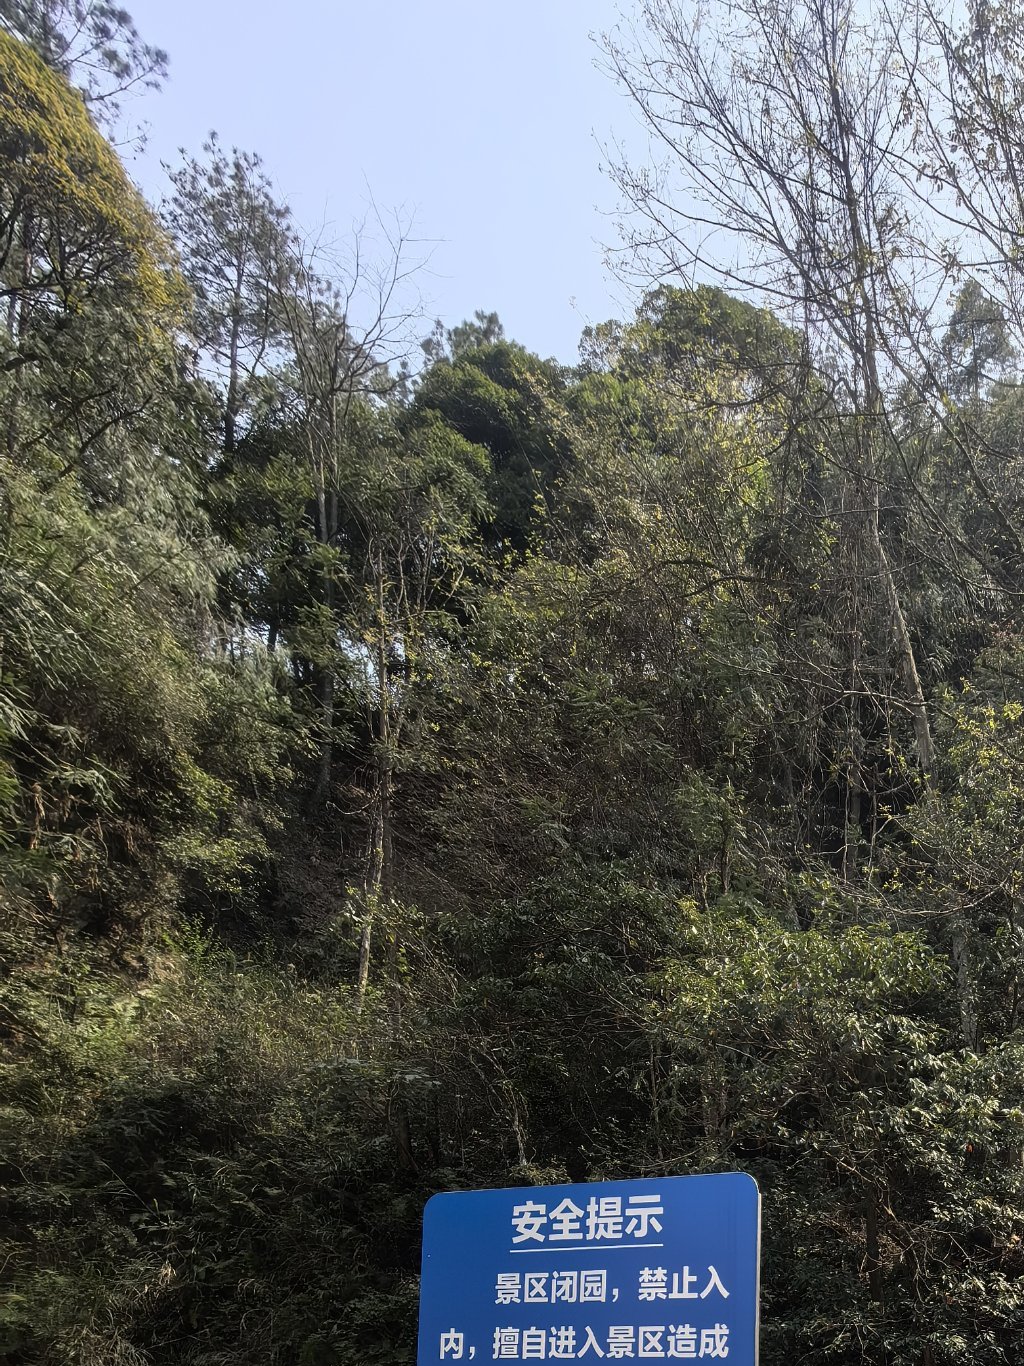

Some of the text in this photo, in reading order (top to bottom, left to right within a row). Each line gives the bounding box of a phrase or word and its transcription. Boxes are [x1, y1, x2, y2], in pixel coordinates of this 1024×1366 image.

[511, 1194, 664, 1244] 安全提示
[495, 1265, 730, 1305] 景区闭园，禁止入
[439, 1323, 730, 1360] 内，擅自进入景区造成
